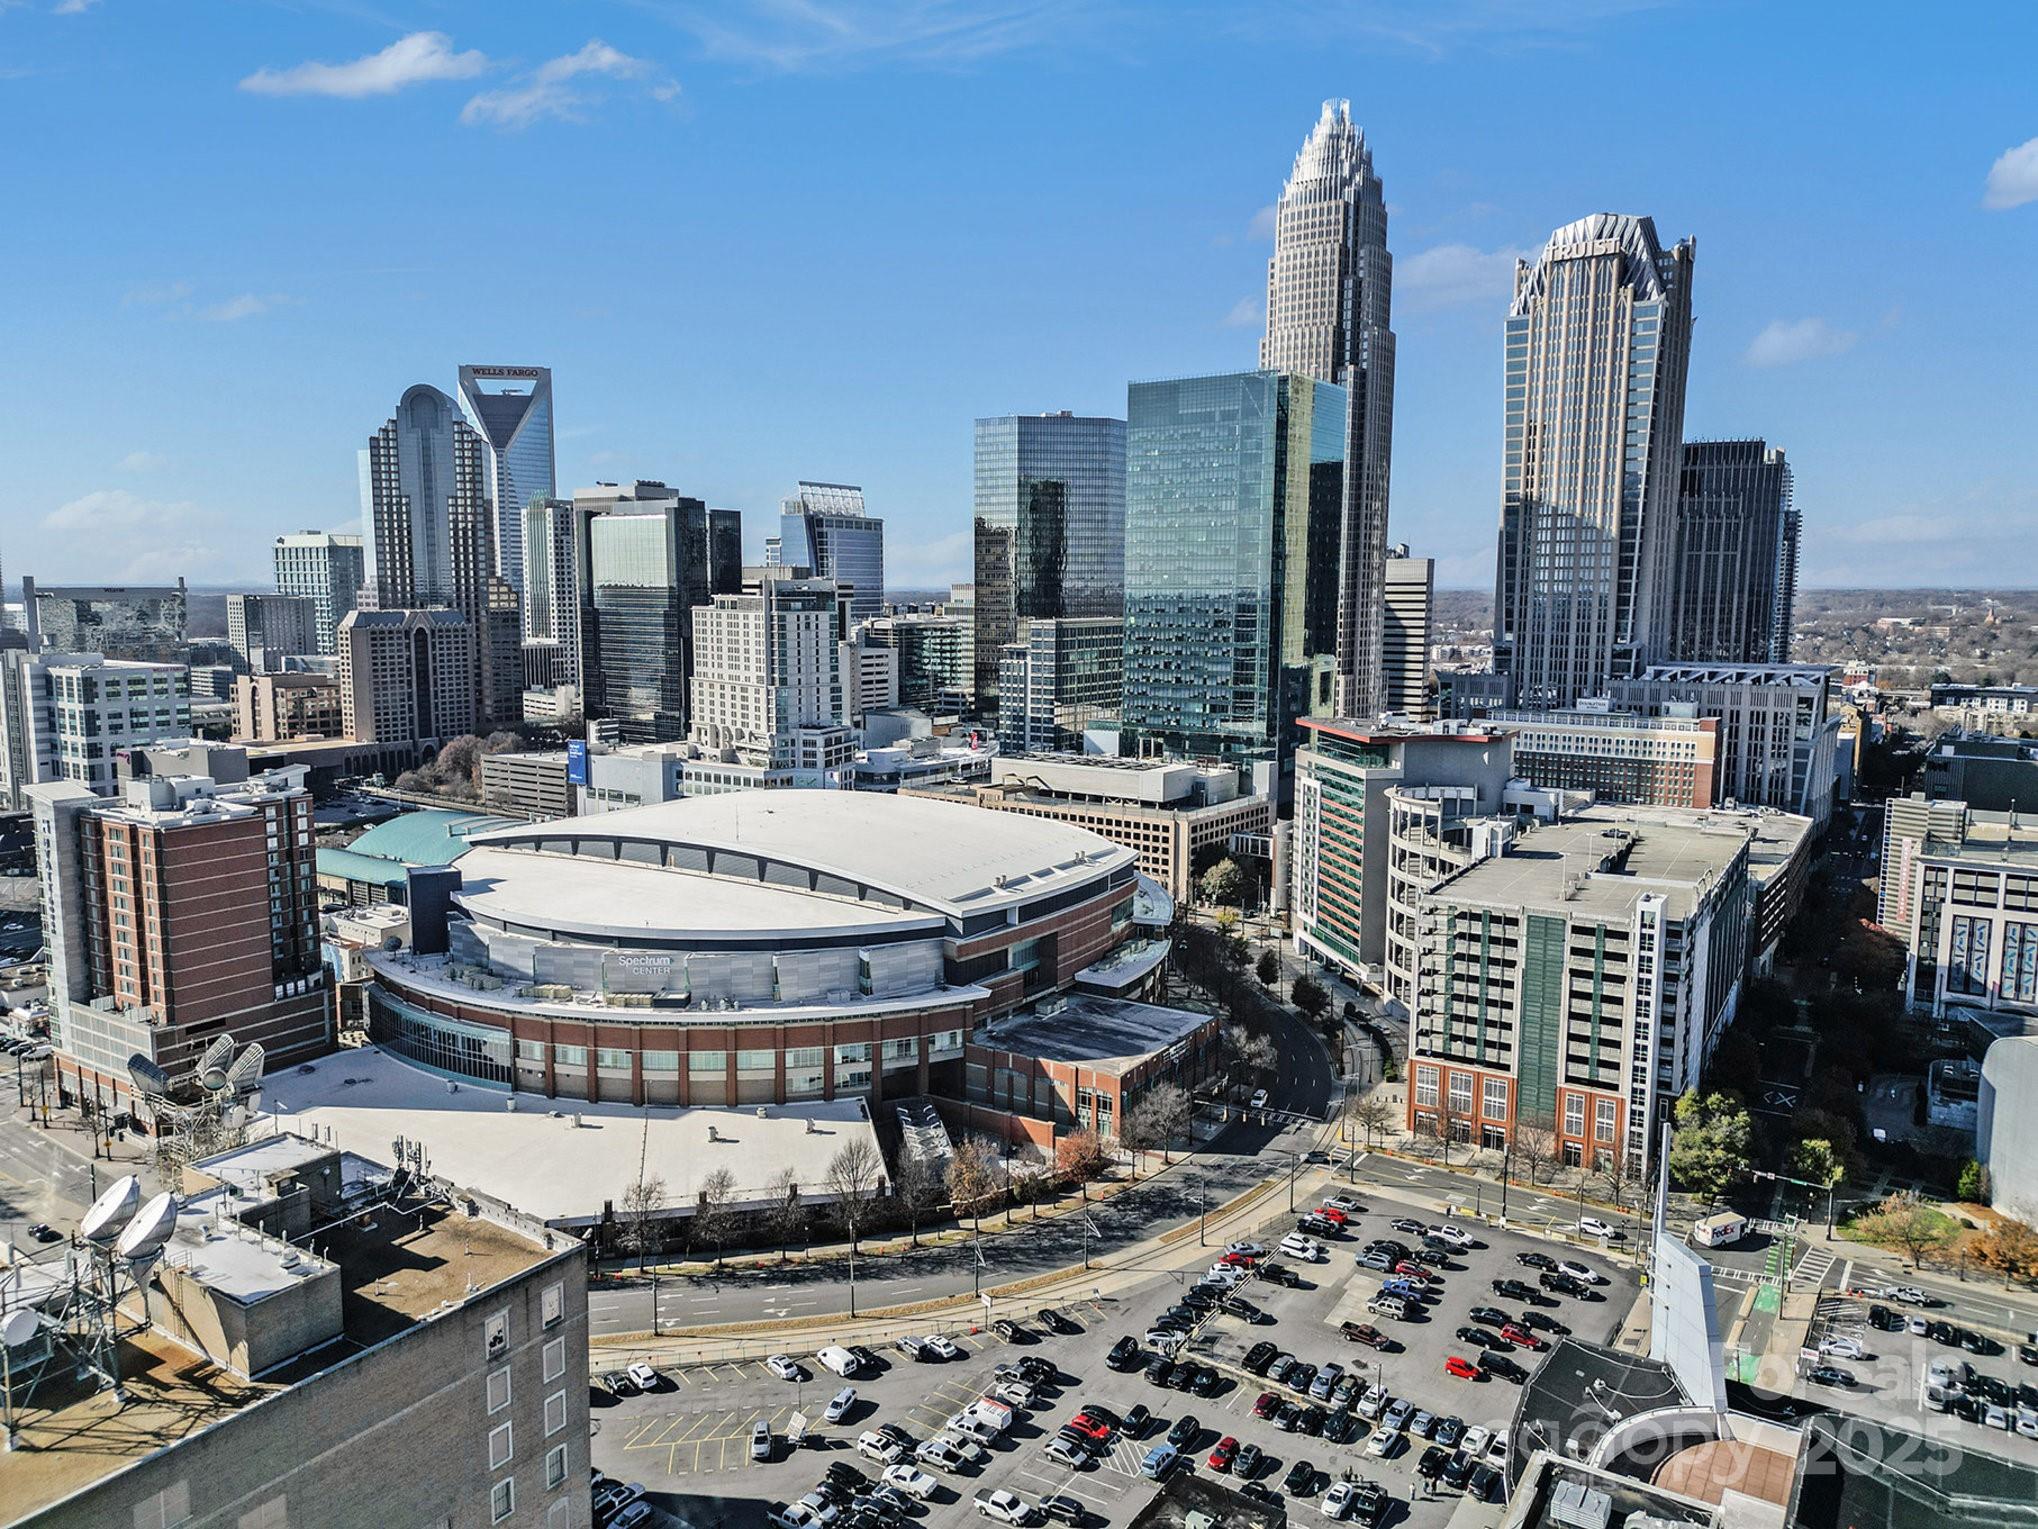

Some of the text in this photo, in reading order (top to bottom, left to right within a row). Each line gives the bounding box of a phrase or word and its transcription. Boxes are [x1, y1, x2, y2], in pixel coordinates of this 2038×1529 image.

[1546, 238, 1620, 261] TRUIST
[471, 367, 538, 377] WELLS FARGO
[618, 955, 671, 968] Spectrum
[632, 967, 671, 975] CENTER
[1712, 1223, 1735, 1239] FedEx
